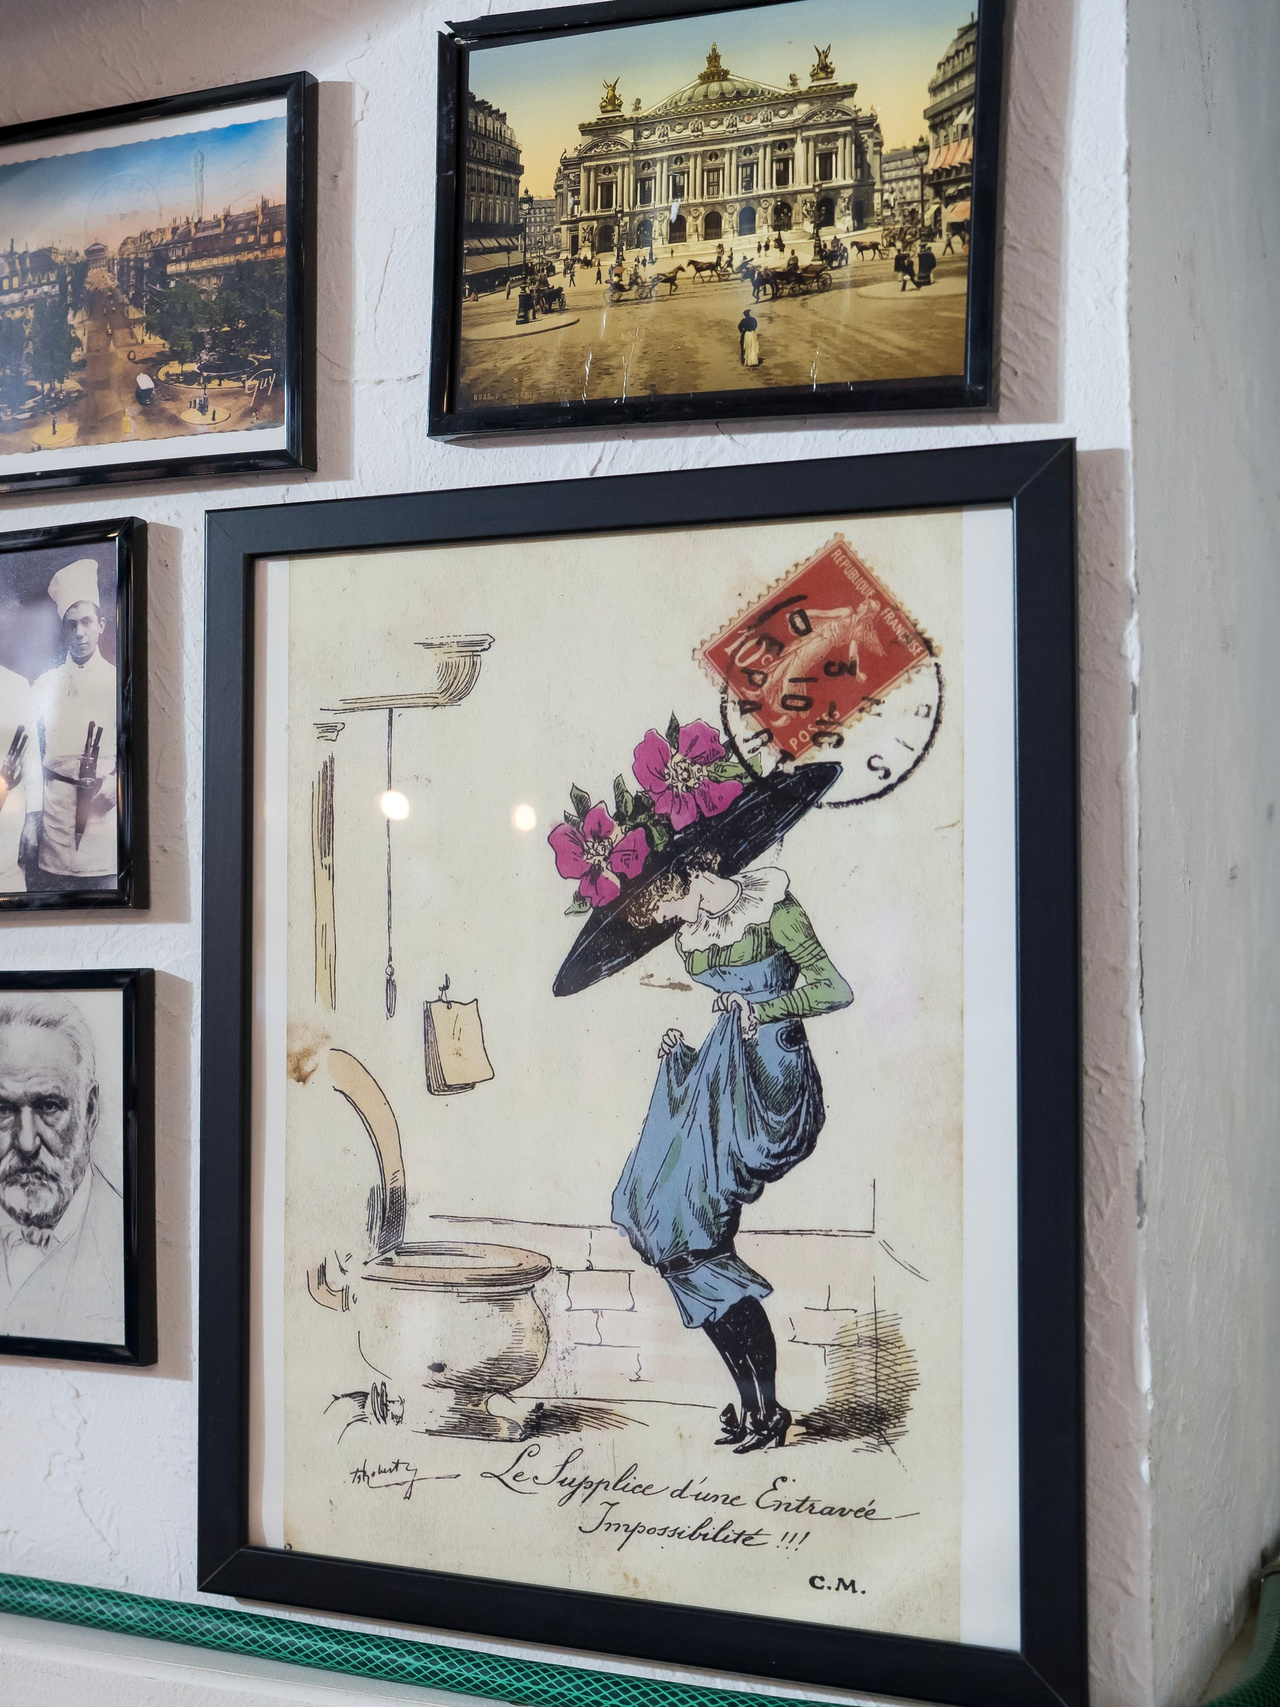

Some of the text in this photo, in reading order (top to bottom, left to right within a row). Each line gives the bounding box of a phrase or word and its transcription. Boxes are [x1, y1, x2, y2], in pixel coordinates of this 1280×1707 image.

[245, 368, 277, 407] Guy
[831, 548, 924, 657] REPUBLIQUE FRANÇISE
[480, 1444, 892, 1521] Le Supplice d'une Entravée
[579, 1501, 772, 1552] Impossibilité
[808, 1575, 867, 1595] C.M.
